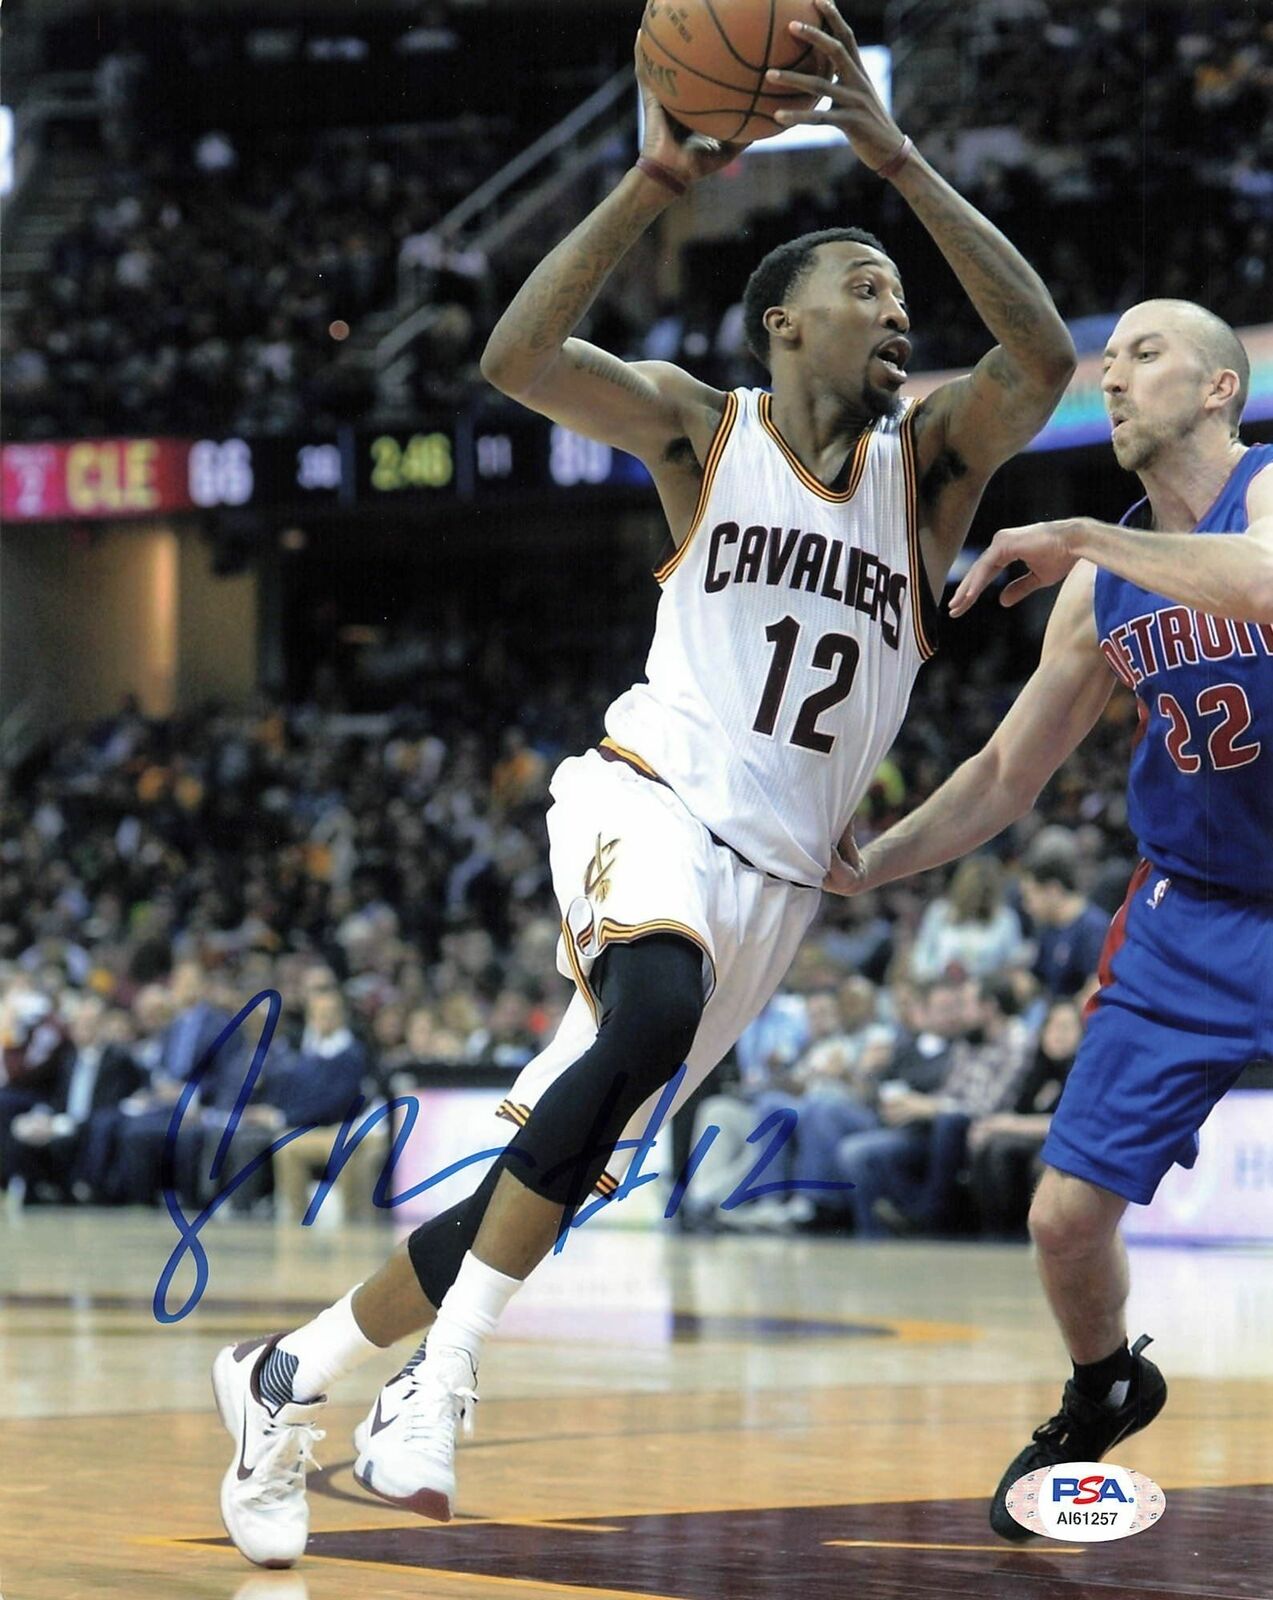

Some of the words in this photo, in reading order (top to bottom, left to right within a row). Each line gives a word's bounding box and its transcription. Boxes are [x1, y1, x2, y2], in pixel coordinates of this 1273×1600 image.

[65, 440, 158, 512] CLE
[704, 521, 908, 650] CAVALIERS
[752, 615, 860, 755] 12
[1158, 683, 1262, 774] 22
